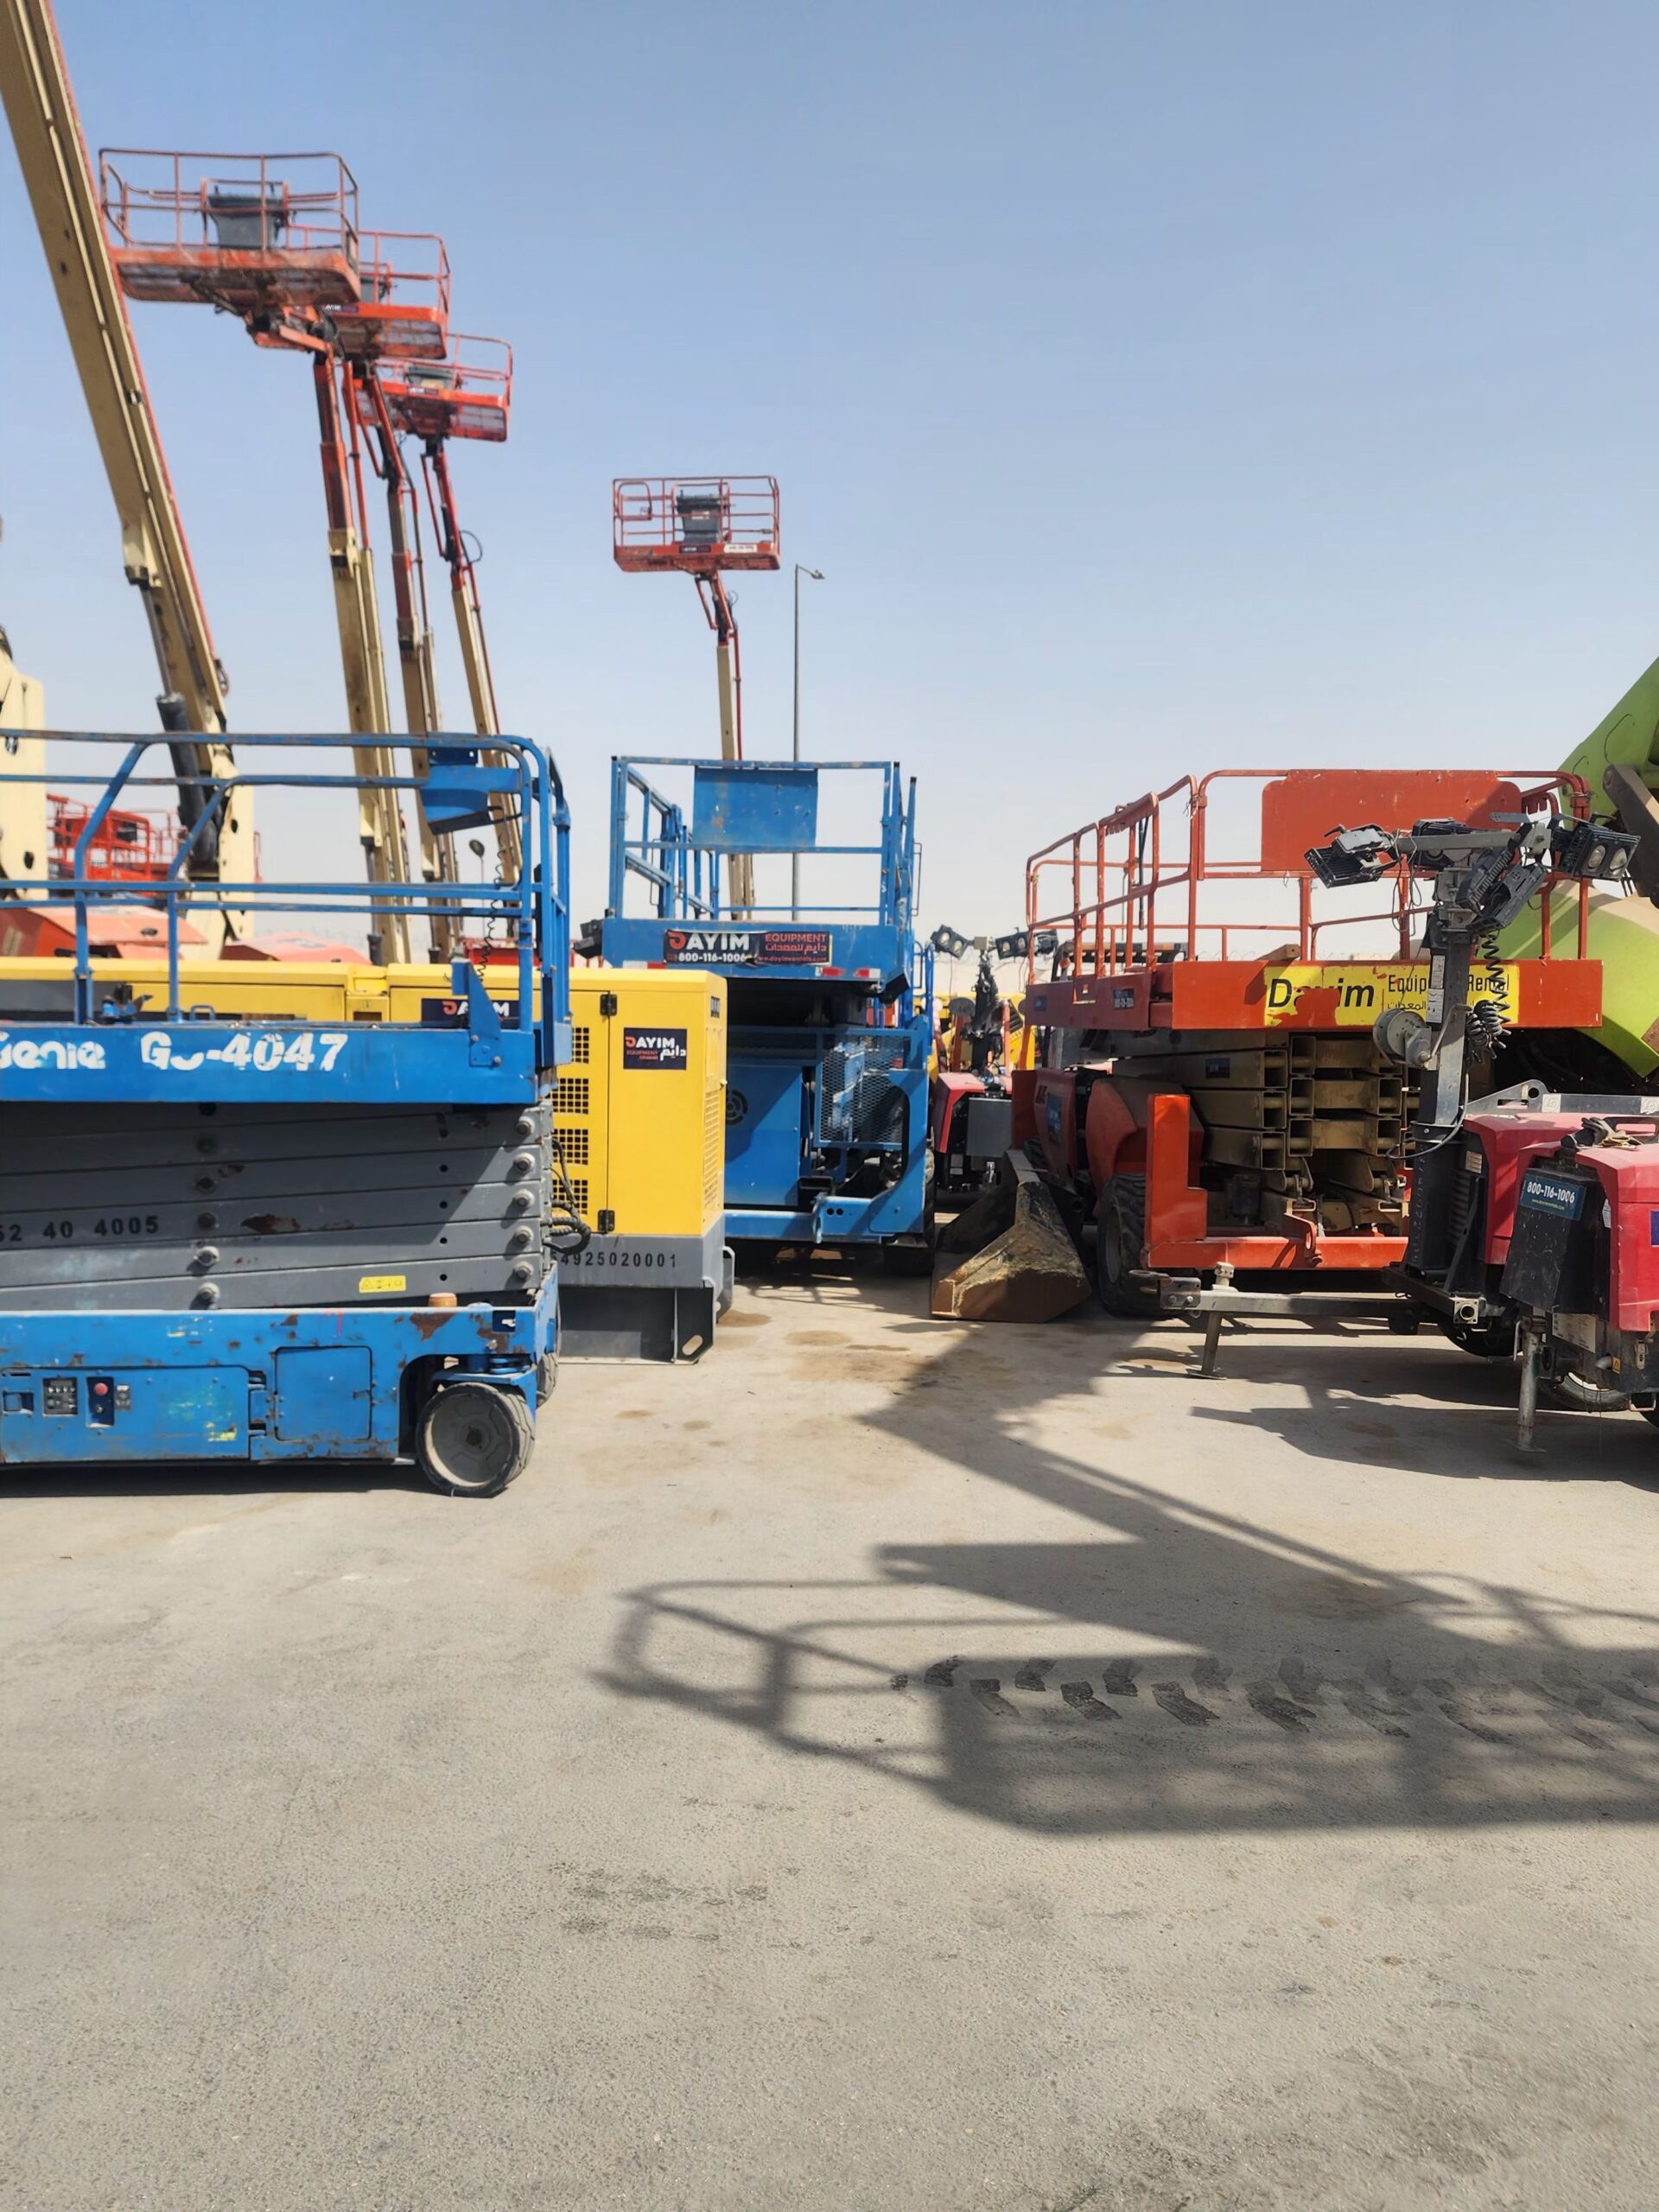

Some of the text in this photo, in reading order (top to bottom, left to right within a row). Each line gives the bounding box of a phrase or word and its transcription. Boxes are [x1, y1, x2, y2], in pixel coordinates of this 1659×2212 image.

[668, 931, 749, 950] DAYIM
[765, 933, 827, 943] EQUIPMENT
[678, 952, 747, 963] 800-116-1006
[1268, 977, 1375, 1007] Dim
[625, 1036, 676, 1049] DAYIM
[1527, 1181, 1575, 1204] 800-116-1006
[43, 1220, 73, 1239] 40
[93, 1215, 159, 1236] 4005
